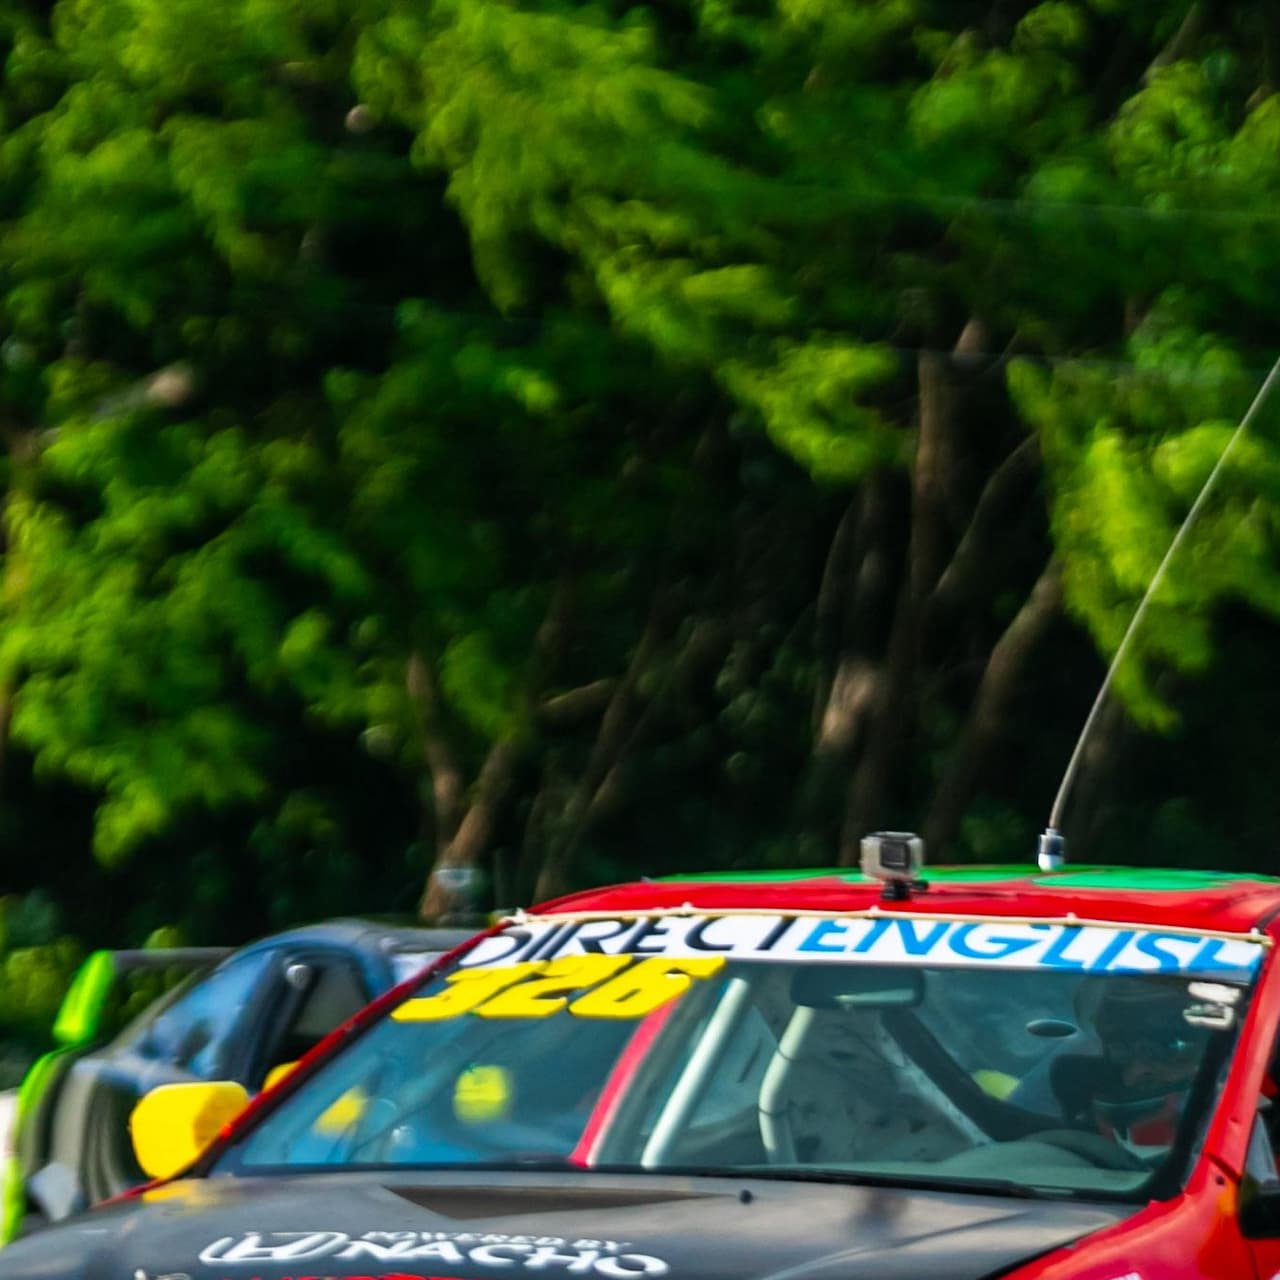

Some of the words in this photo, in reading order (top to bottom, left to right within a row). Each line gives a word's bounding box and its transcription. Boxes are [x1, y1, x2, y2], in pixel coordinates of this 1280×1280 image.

[391, 952, 726, 1021] 326
[332, 1239, 670, 1280] NACHO
[360, 1231, 566, 1246] POWERED
[570, 1239, 633, 1253] BY
